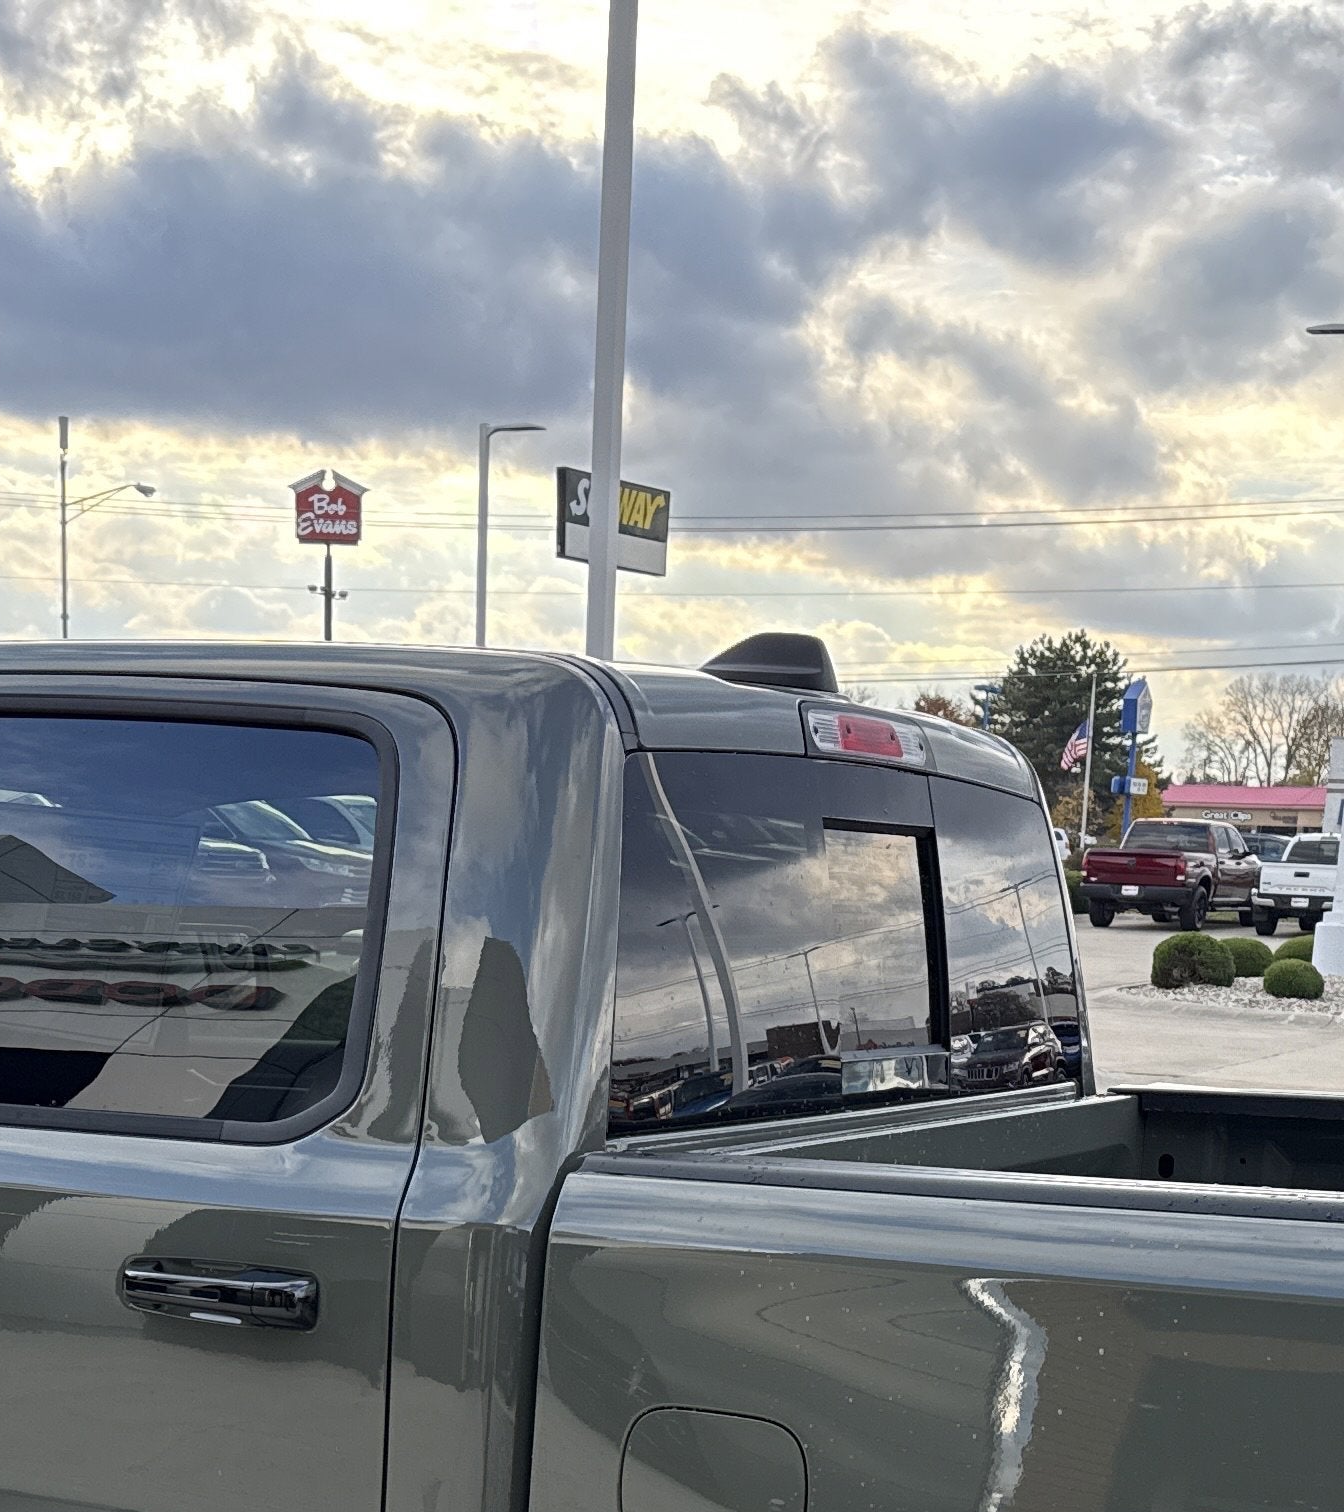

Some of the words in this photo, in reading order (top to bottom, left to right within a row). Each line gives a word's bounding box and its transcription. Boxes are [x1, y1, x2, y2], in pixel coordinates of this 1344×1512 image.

[308, 493, 347, 516] Bob
[568, 477, 666, 531] SWAY
[297, 511, 358, 536] Evans
[1201, 809, 1228, 820] Great
[1230, 810, 1253, 822] Clips
